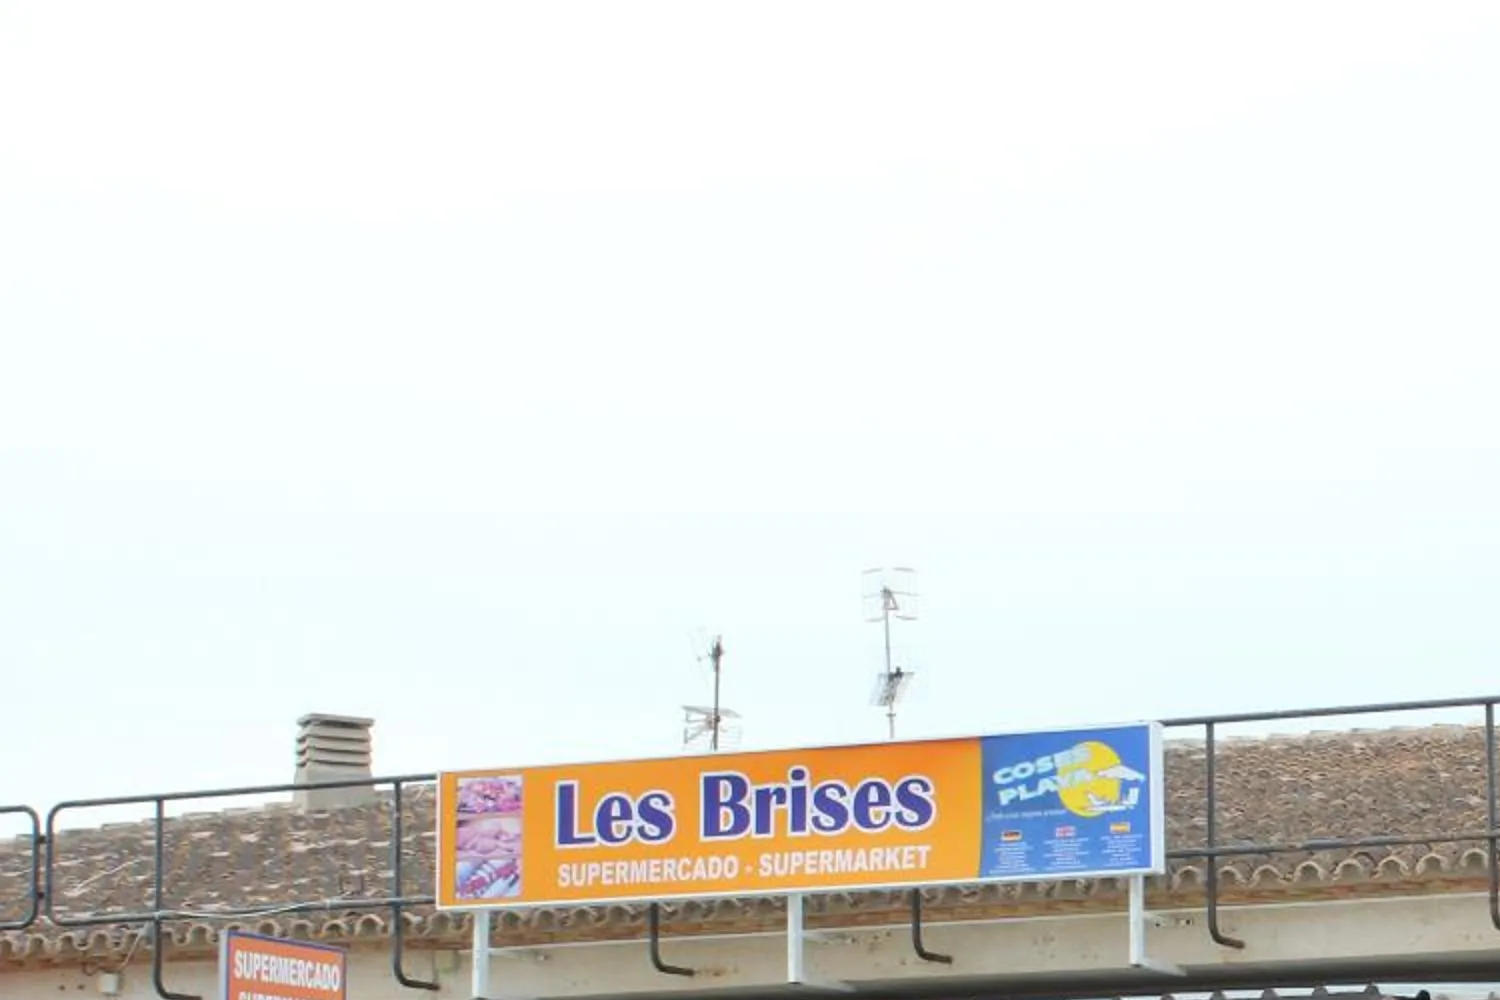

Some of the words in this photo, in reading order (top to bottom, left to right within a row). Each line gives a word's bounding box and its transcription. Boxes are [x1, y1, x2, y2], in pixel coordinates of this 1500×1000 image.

[555, 779, 677, 849] Les
[700, 765, 937, 842] Brises
[557, 855, 740, 888] SUPERMERCADO
[758, 844, 931, 877] SUPERMARKET
[235, 949, 340, 992] SUPERMERCADO
